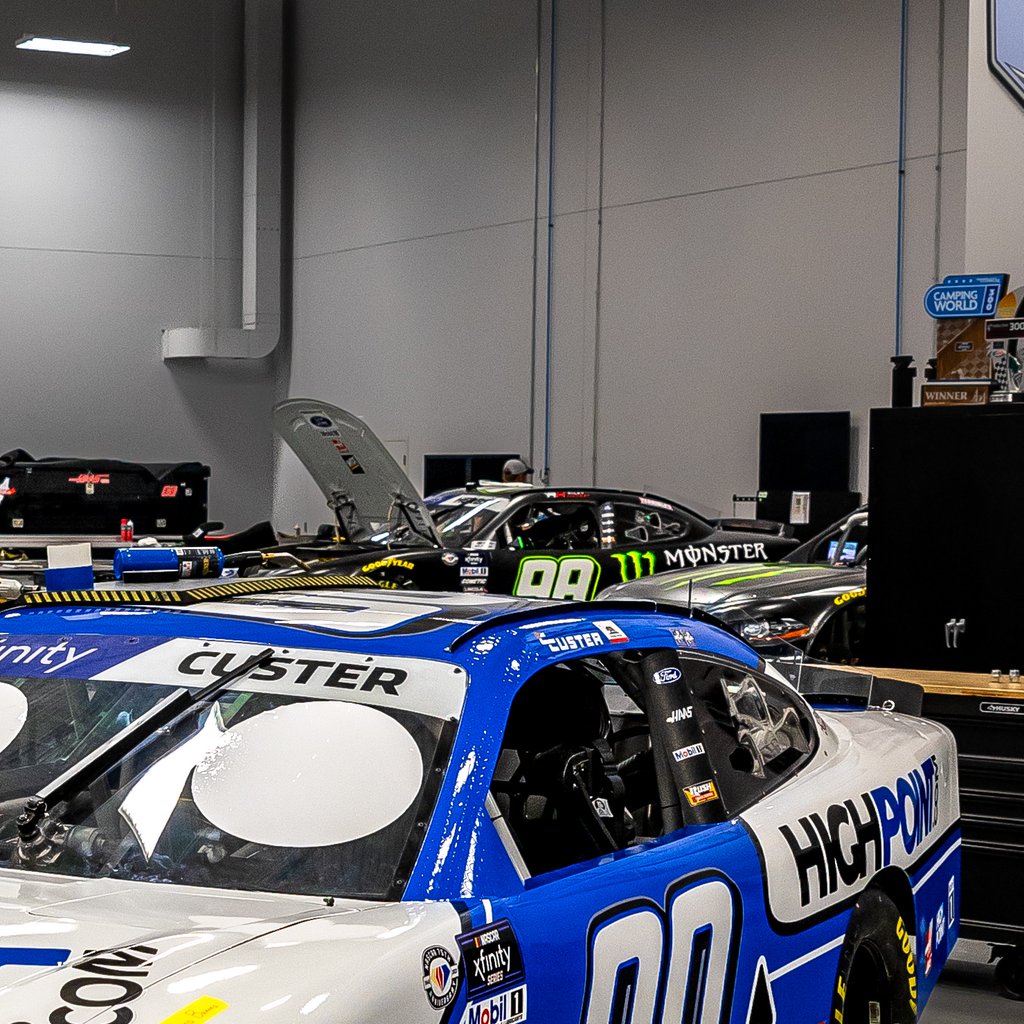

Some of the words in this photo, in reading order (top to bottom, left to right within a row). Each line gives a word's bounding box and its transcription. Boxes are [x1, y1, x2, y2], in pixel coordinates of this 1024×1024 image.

[933, 290, 978, 301] CAMPING
[934, 301, 978, 312] WORLD
[925, 391, 968, 400] WINNER
[663, 543, 768, 568] MONSTER
[361, 557, 415, 573] GOODYEAR
[541, 632, 604, 652] CUSTER
[177, 651, 408, 695] CUSTER
[666, 706, 693, 723] HAAS
[676, 746, 696, 760] Mobil
[689, 782, 712, 796] RUSH
[479, 929, 501, 946] NASCAR
[473, 944, 511, 981] xfinity
[487, 970, 504, 986] SERIES
